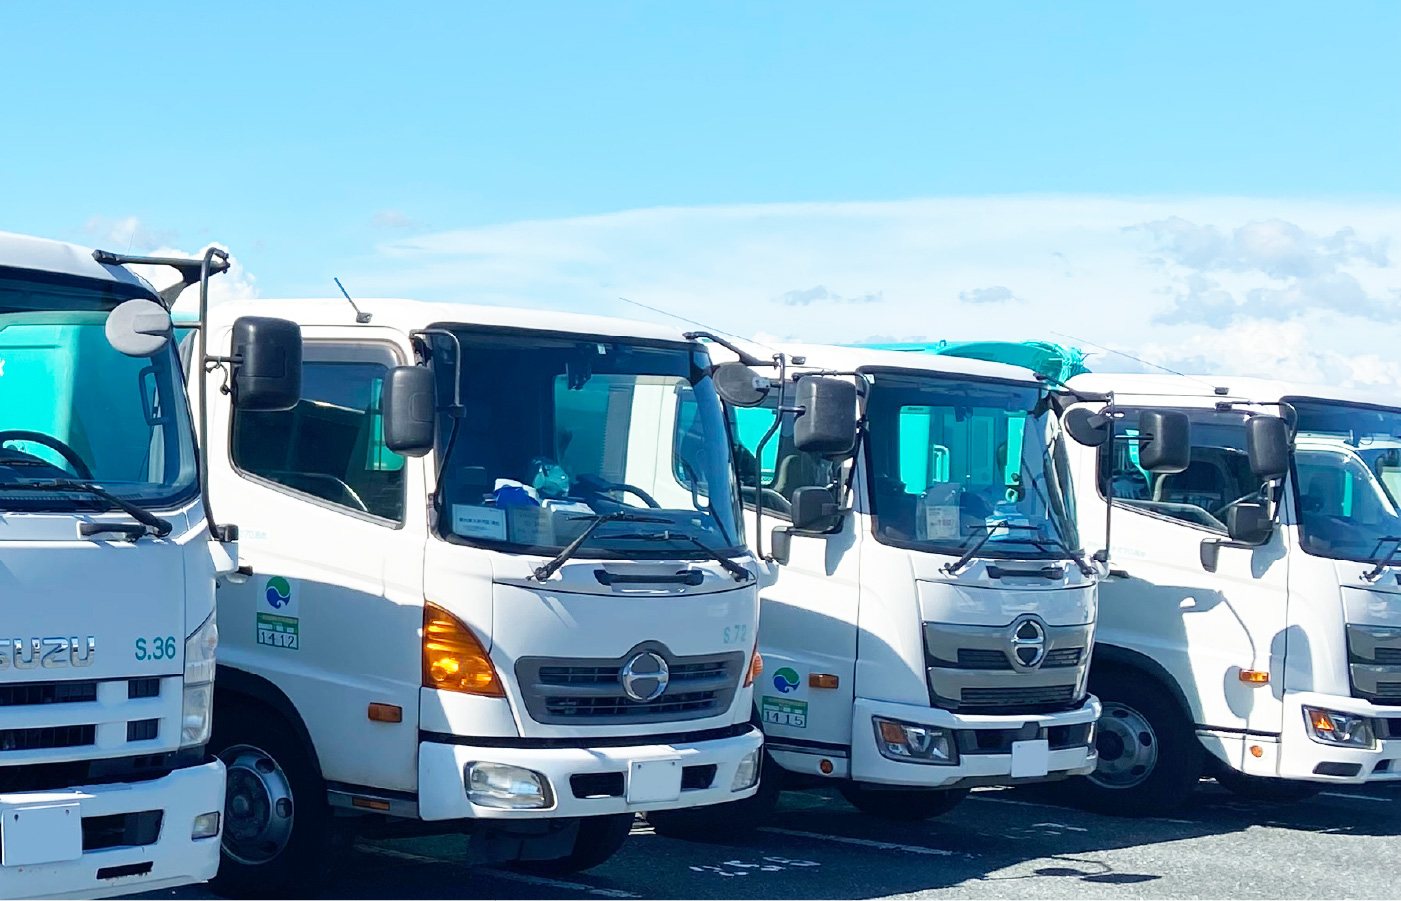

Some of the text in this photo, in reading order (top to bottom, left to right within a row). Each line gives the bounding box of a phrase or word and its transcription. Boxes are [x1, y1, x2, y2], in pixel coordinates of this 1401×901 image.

[135, 636, 176, 660] S.36
[261, 631, 295, 648] 1412
[766, 711, 803, 725] 1415
